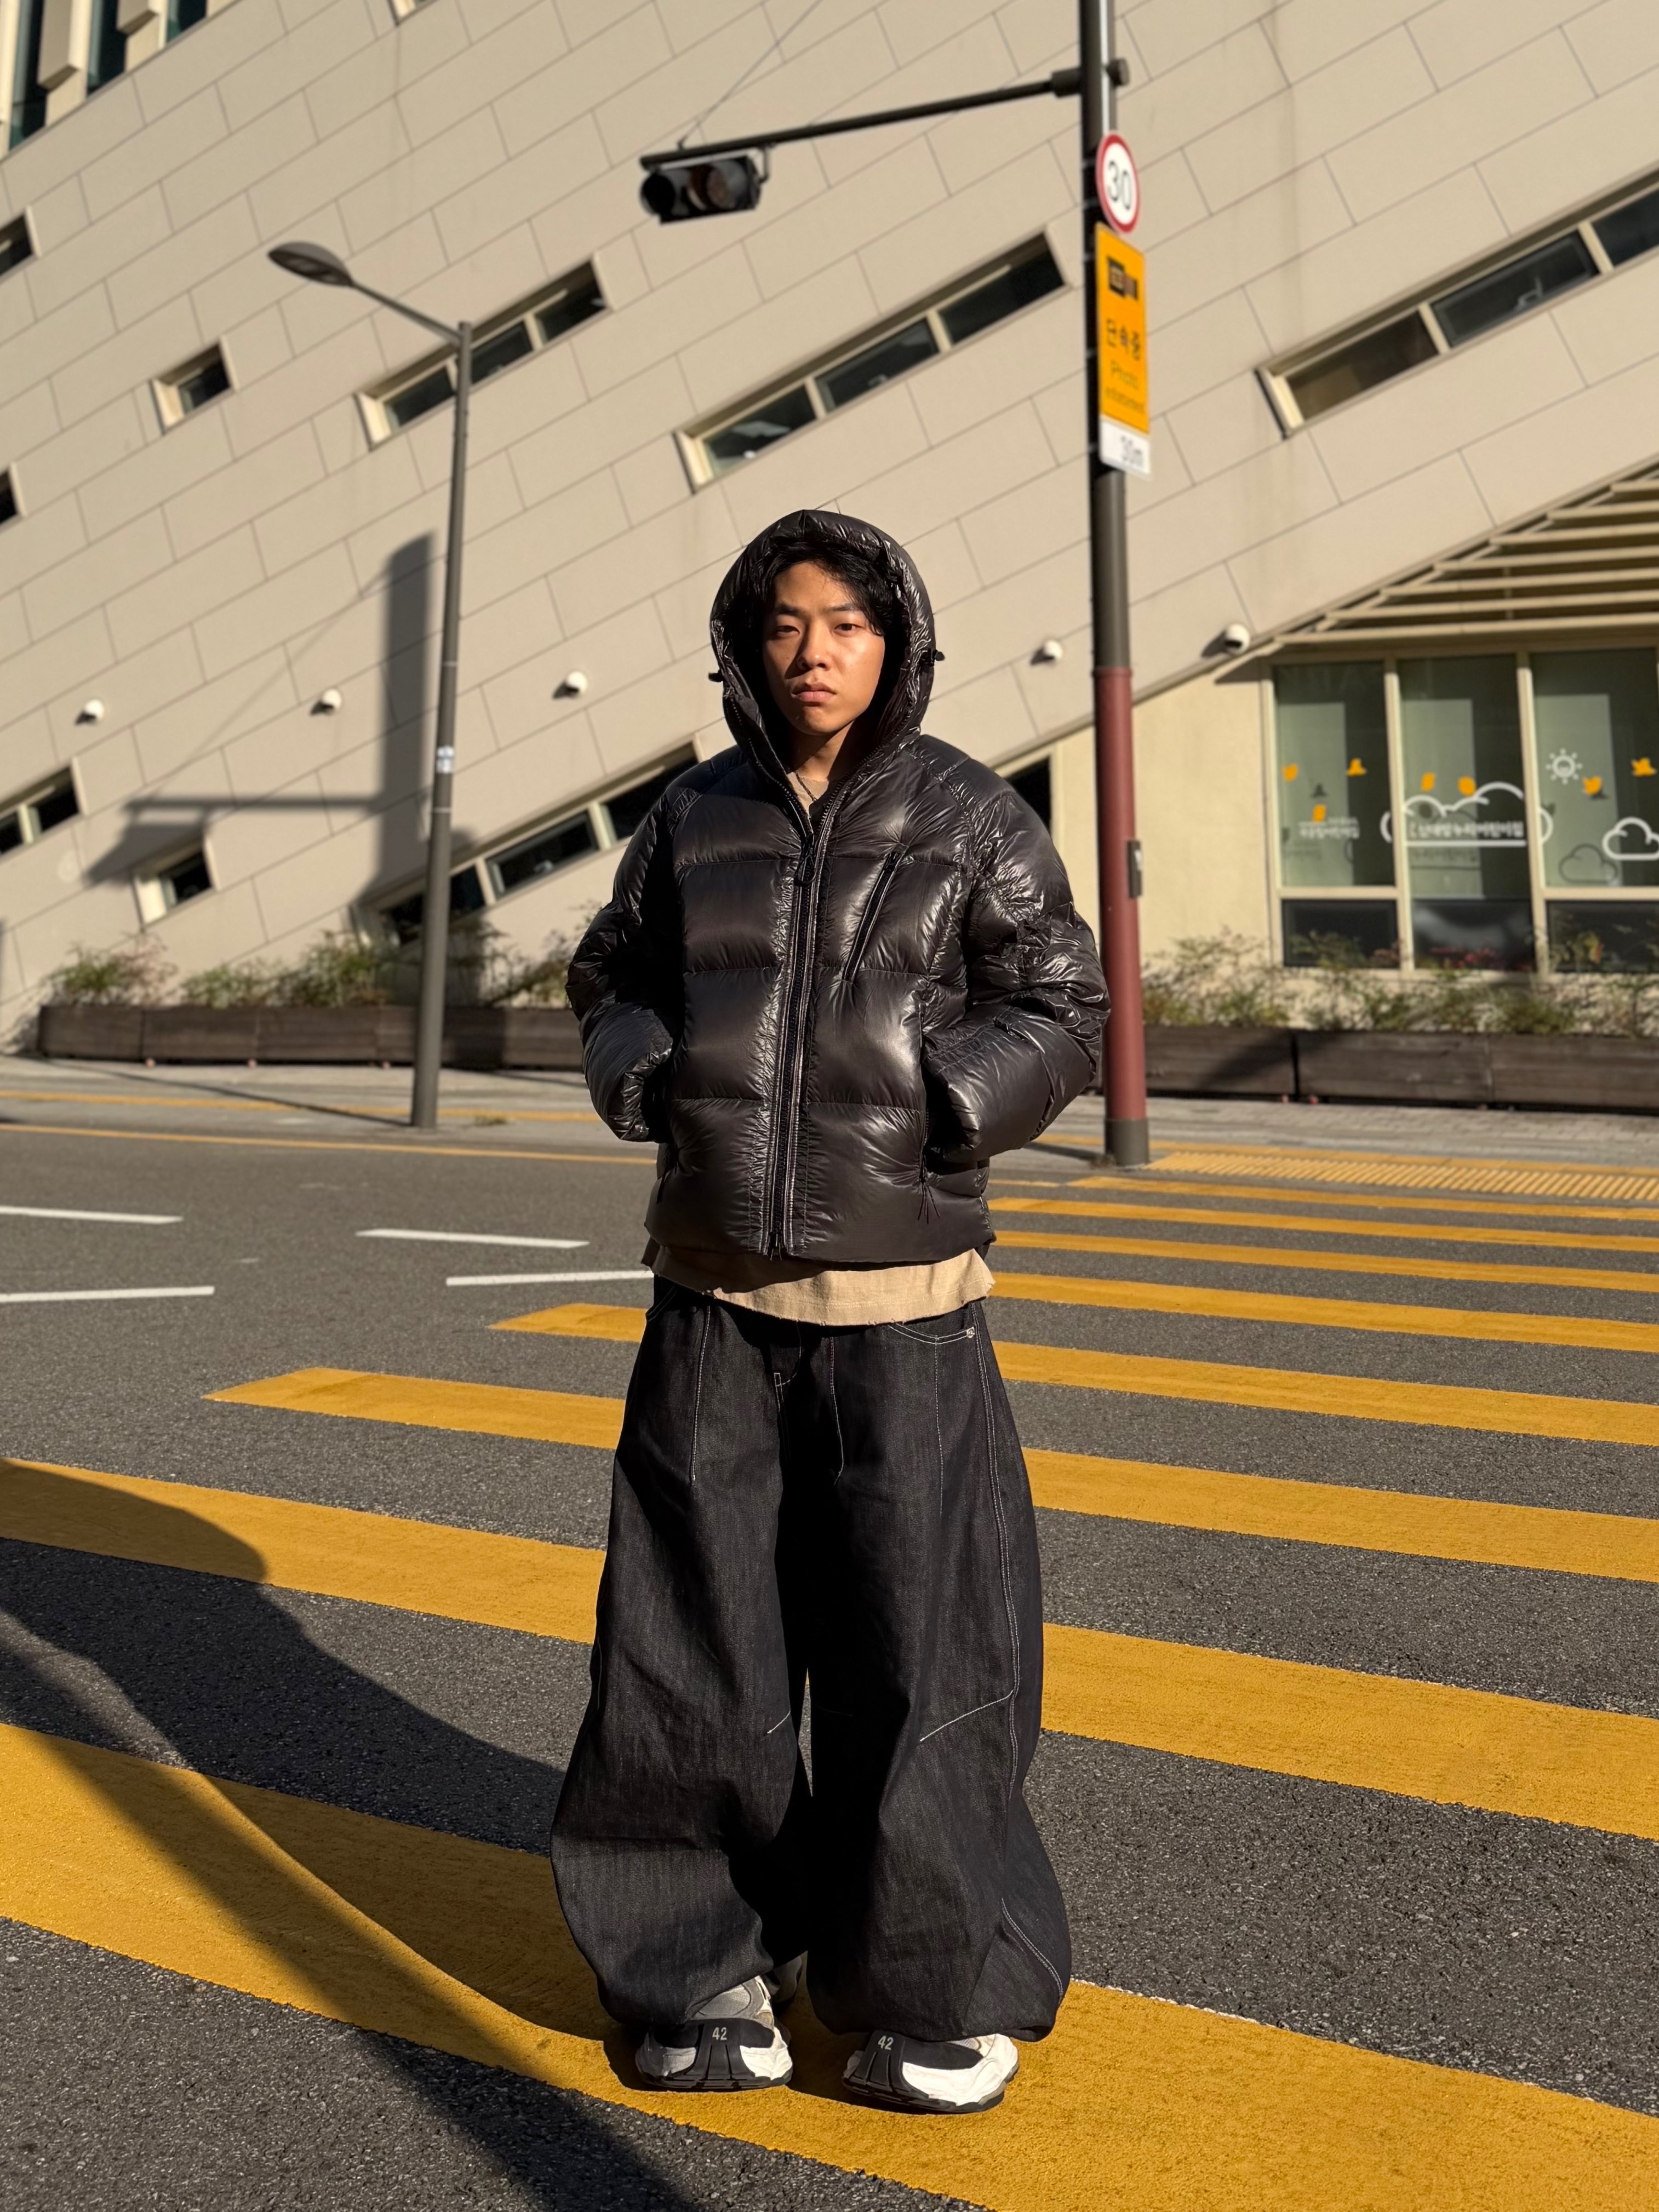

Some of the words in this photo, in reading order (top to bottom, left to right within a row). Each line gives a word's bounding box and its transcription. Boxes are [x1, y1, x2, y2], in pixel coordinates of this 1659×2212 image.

[1108, 160, 1132, 210] 30
[712, 2027, 727, 2041] 42
[878, 2035, 894, 2050] 42
